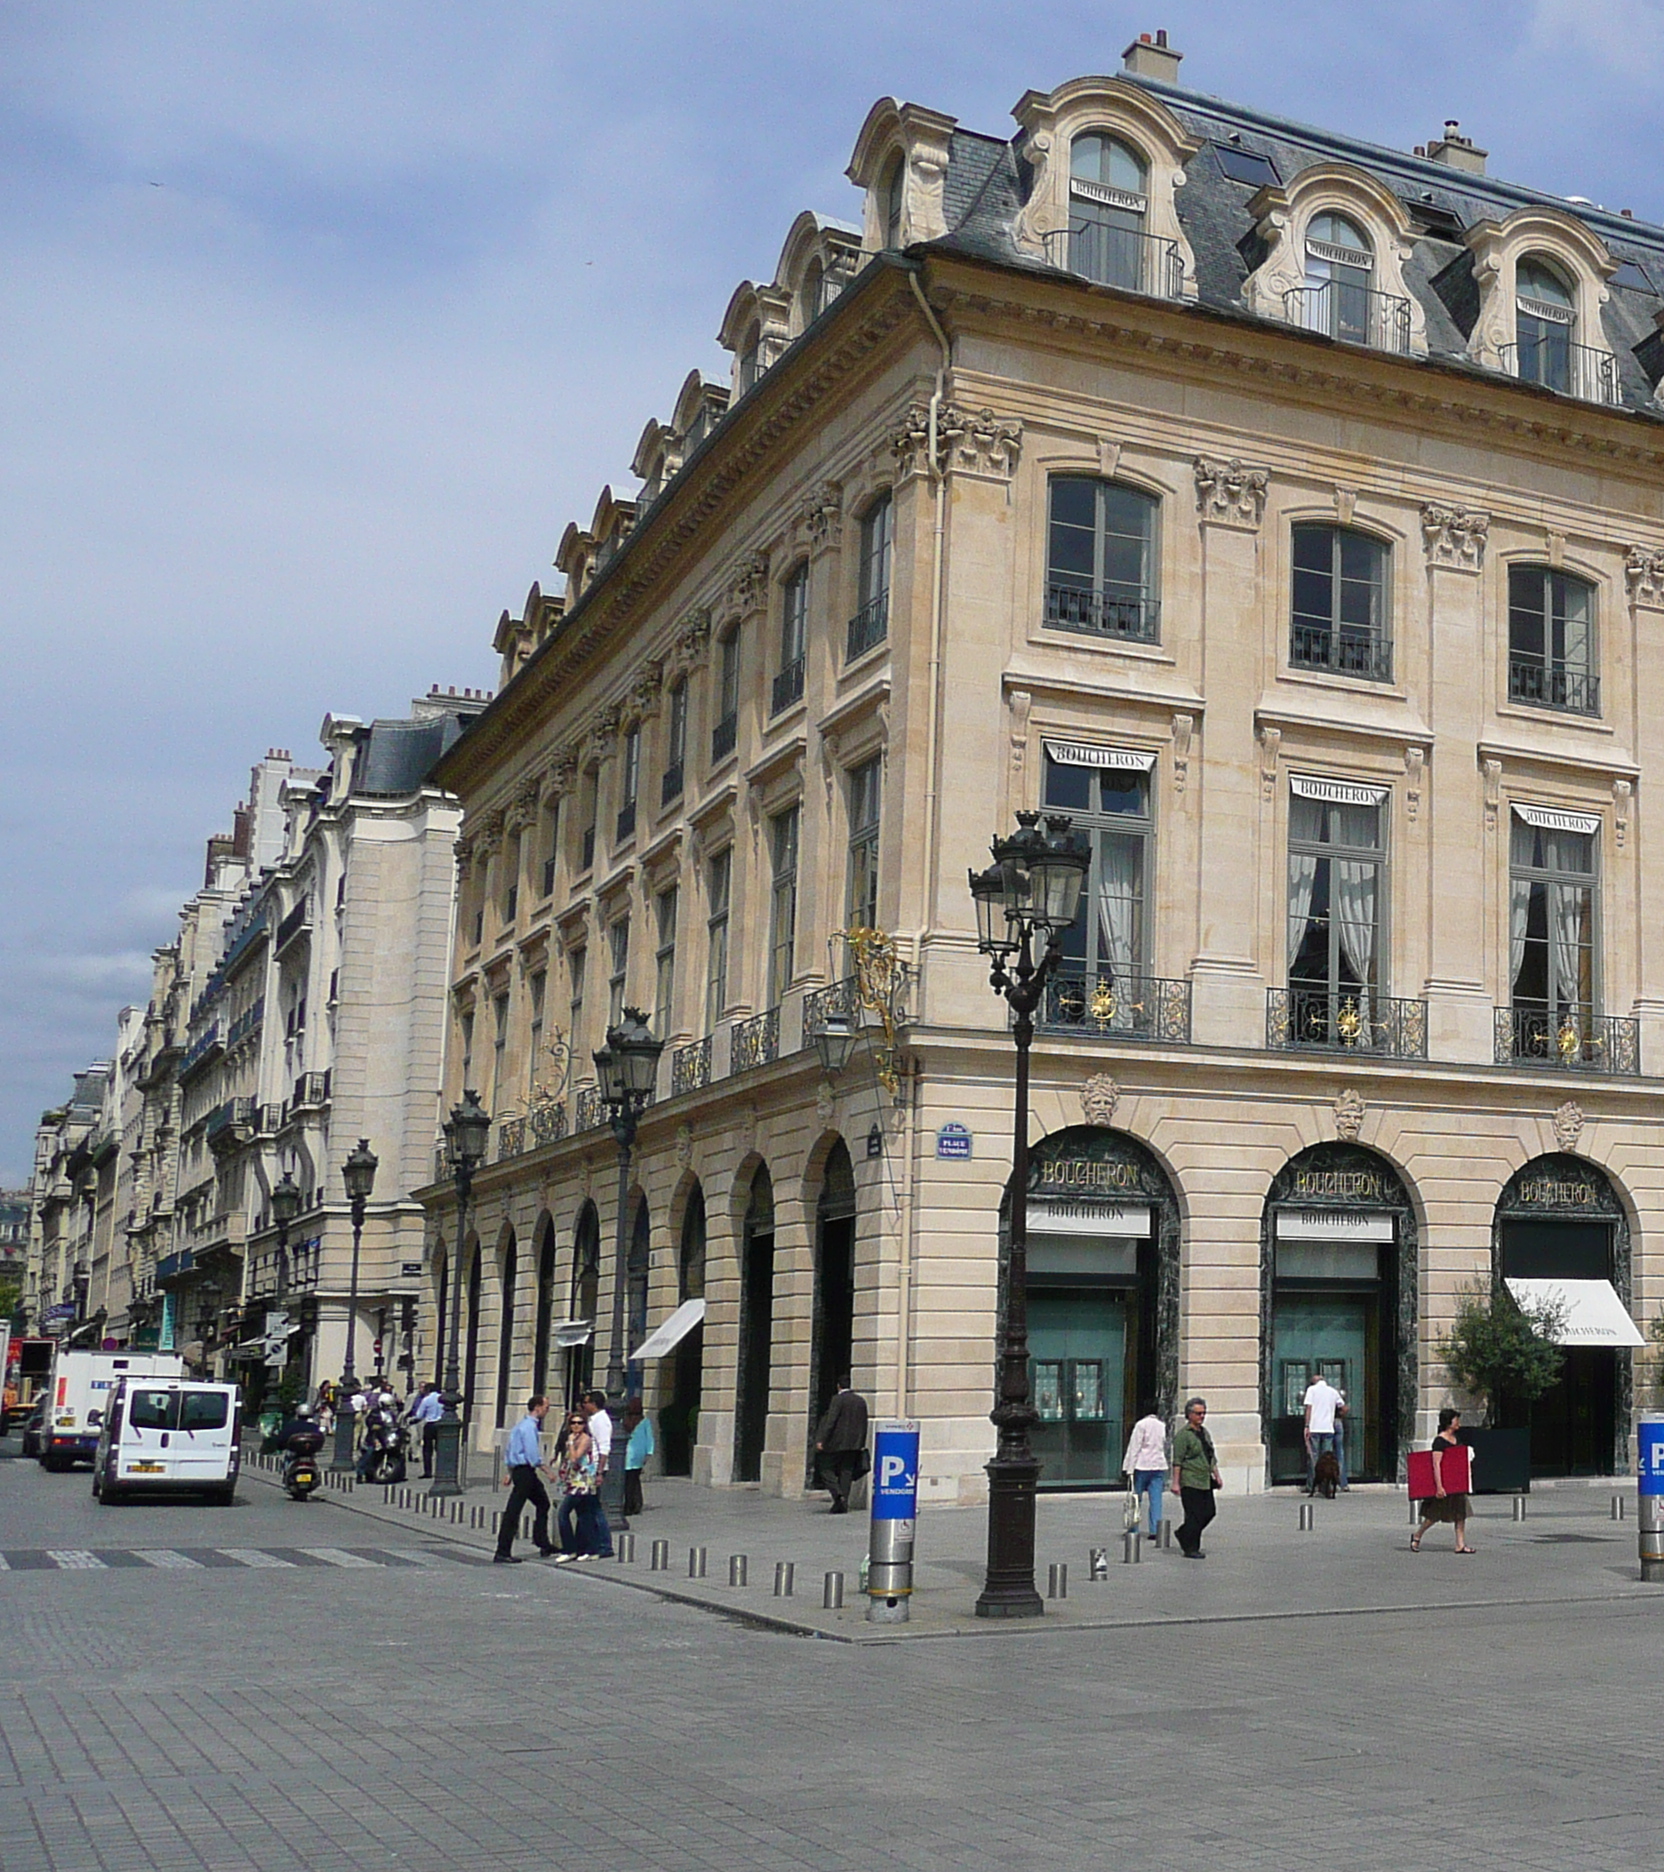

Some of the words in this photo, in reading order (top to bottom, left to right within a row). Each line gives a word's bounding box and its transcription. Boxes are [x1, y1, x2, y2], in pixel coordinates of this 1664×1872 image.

[1056, 746, 1145, 767] BOUCHERON
[1301, 780, 1378, 803] BOUCHERON
[1043, 1161, 1138, 1187] BOUCHERON
[1296, 1171, 1380, 1196] BOUCHERON
[1048, 1205, 1124, 1220] BOUCHERON
[1301, 1212, 1369, 1227] BOUCHERON
[1559, 1326, 1618, 1337] OUCHERON
[881, 1455, 905, 1486] P
